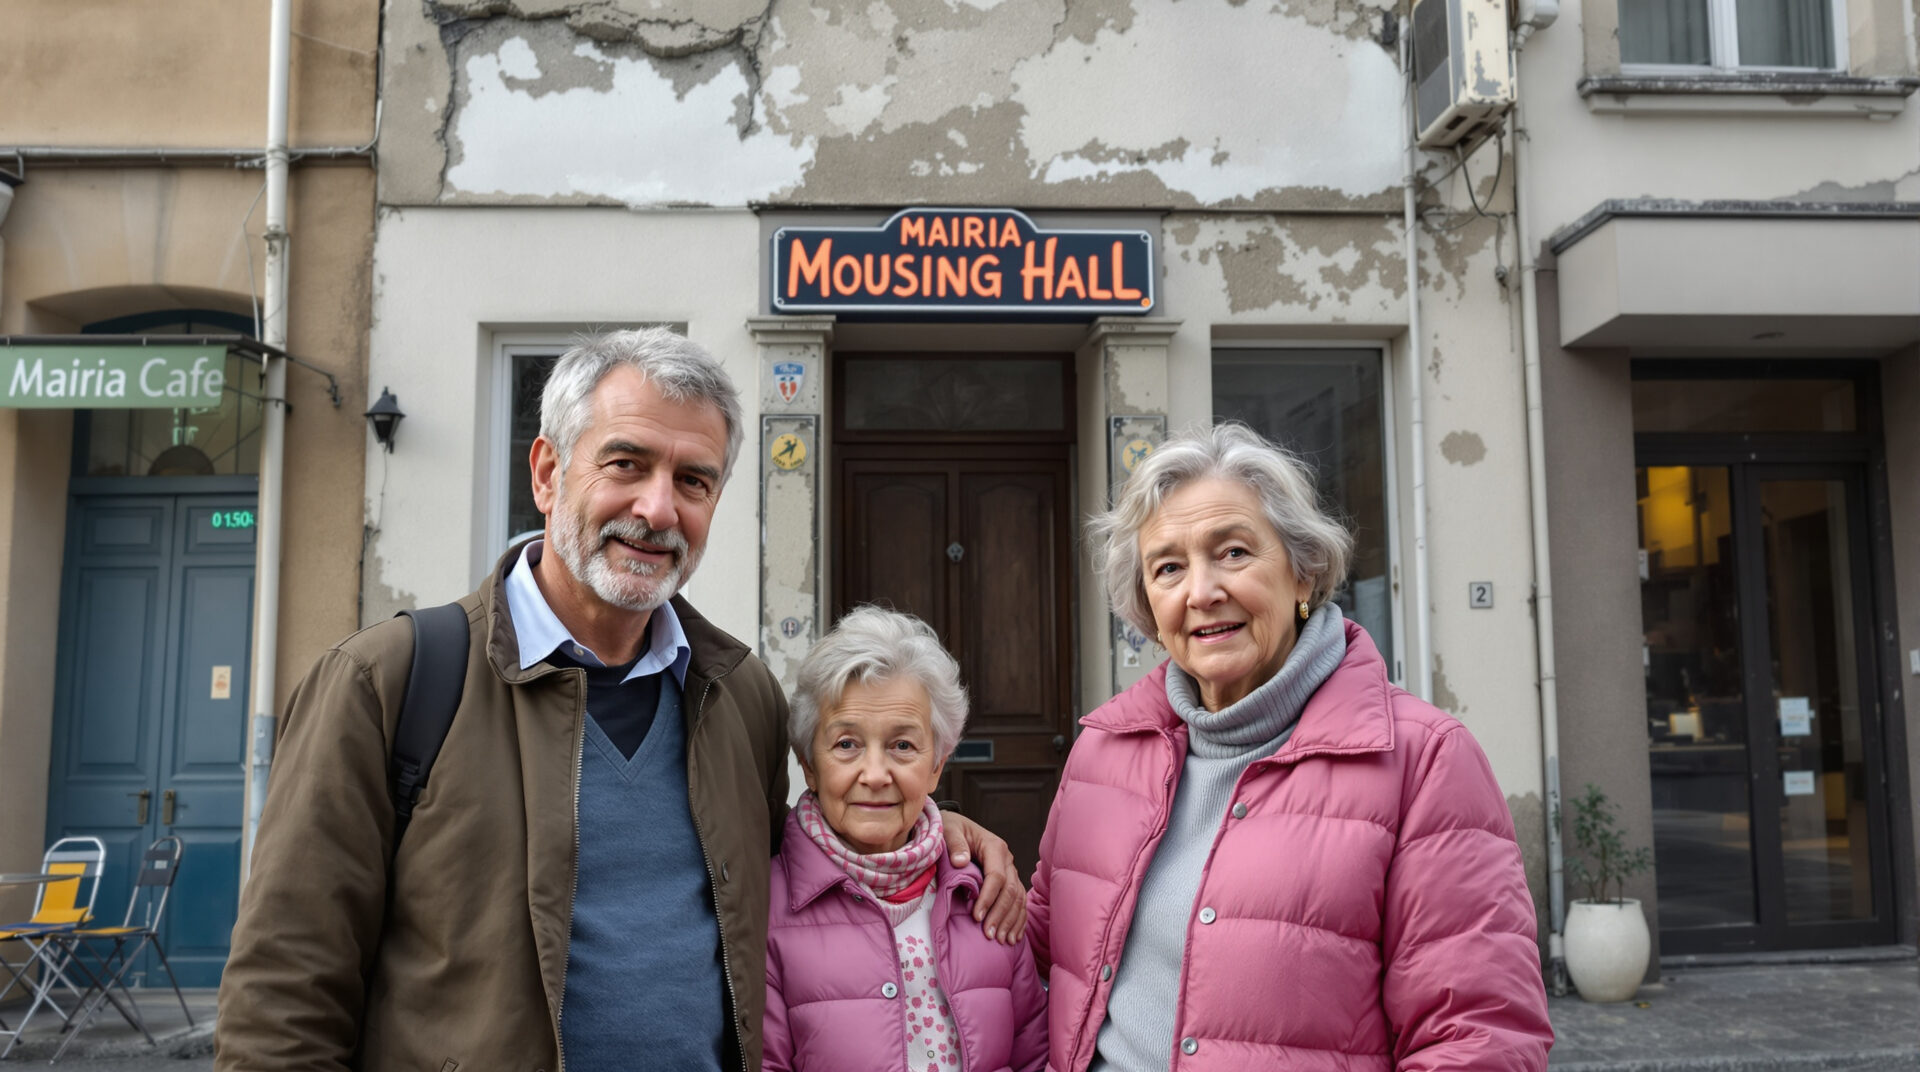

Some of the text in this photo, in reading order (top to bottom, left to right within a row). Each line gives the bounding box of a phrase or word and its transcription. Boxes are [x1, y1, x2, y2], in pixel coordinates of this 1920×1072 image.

[900, 216, 1022, 248] MAIRIA
[787, 236, 1142, 301] MOUSING HALL
[8, 356, 225, 398] Mairia Cafe
[1476, 586, 1487, 603] 2
